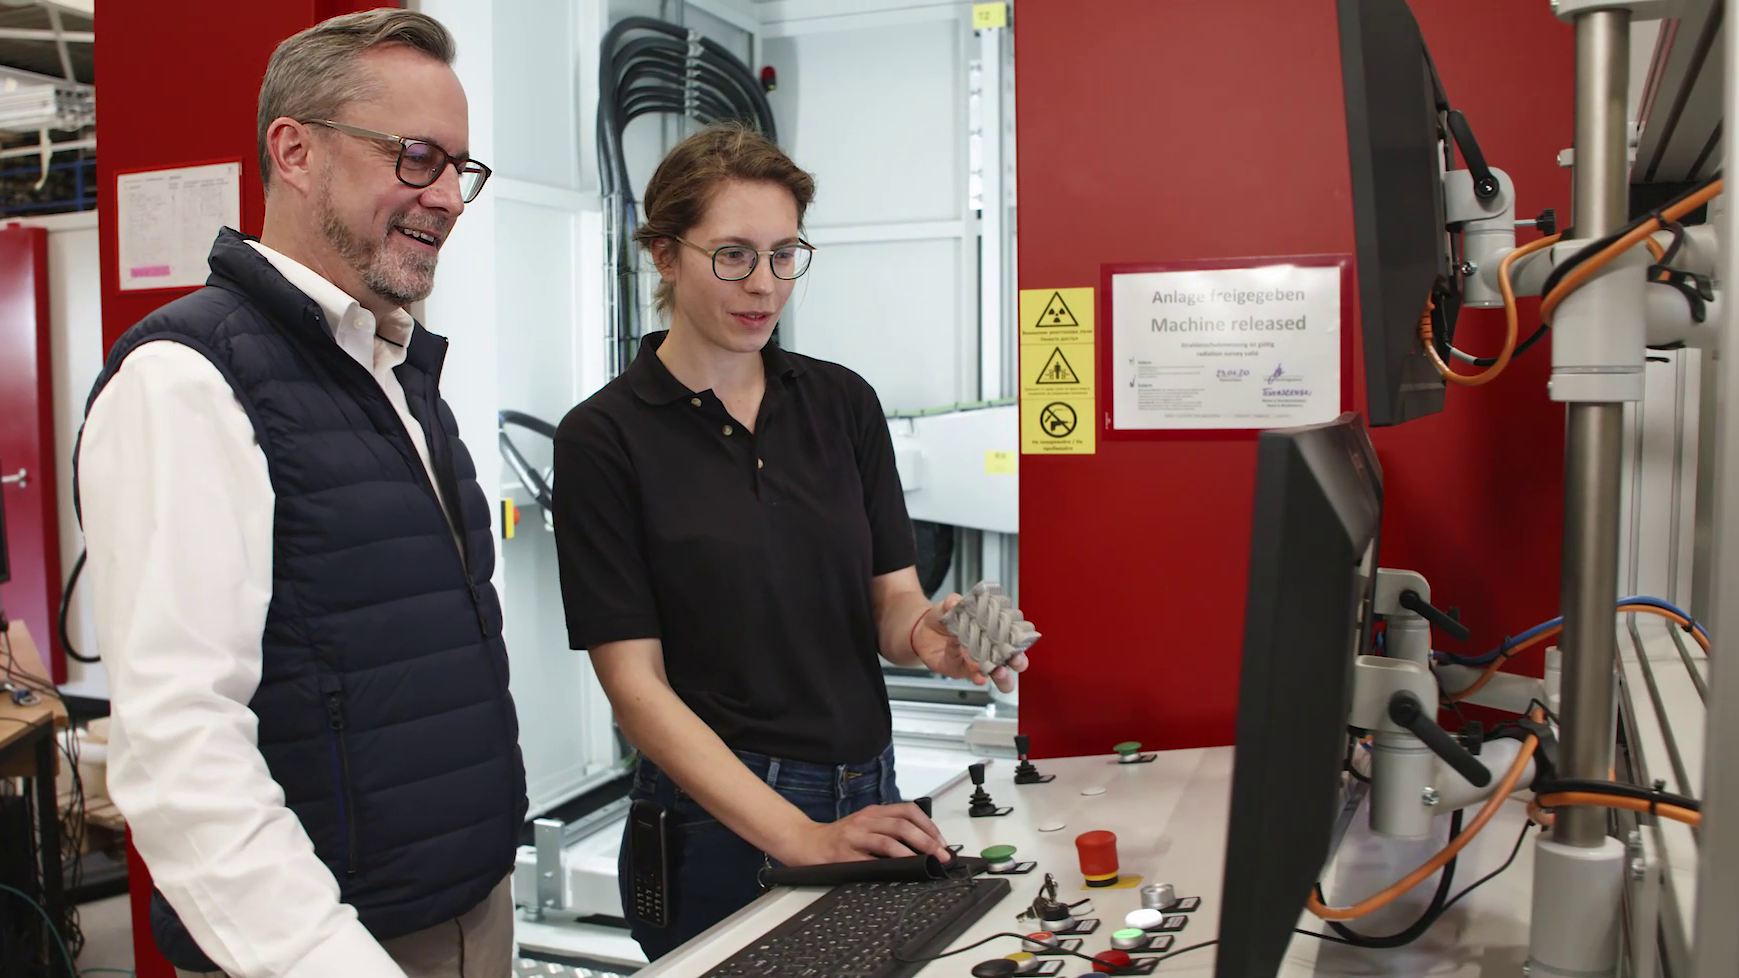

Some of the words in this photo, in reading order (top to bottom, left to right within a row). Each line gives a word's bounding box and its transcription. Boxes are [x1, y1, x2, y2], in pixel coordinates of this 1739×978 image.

[1152, 290, 1205, 306] Anlage
[1210, 288, 1305, 305] freigegeben
[1151, 316, 1225, 333] Machine
[1231, 314, 1307, 331] released
